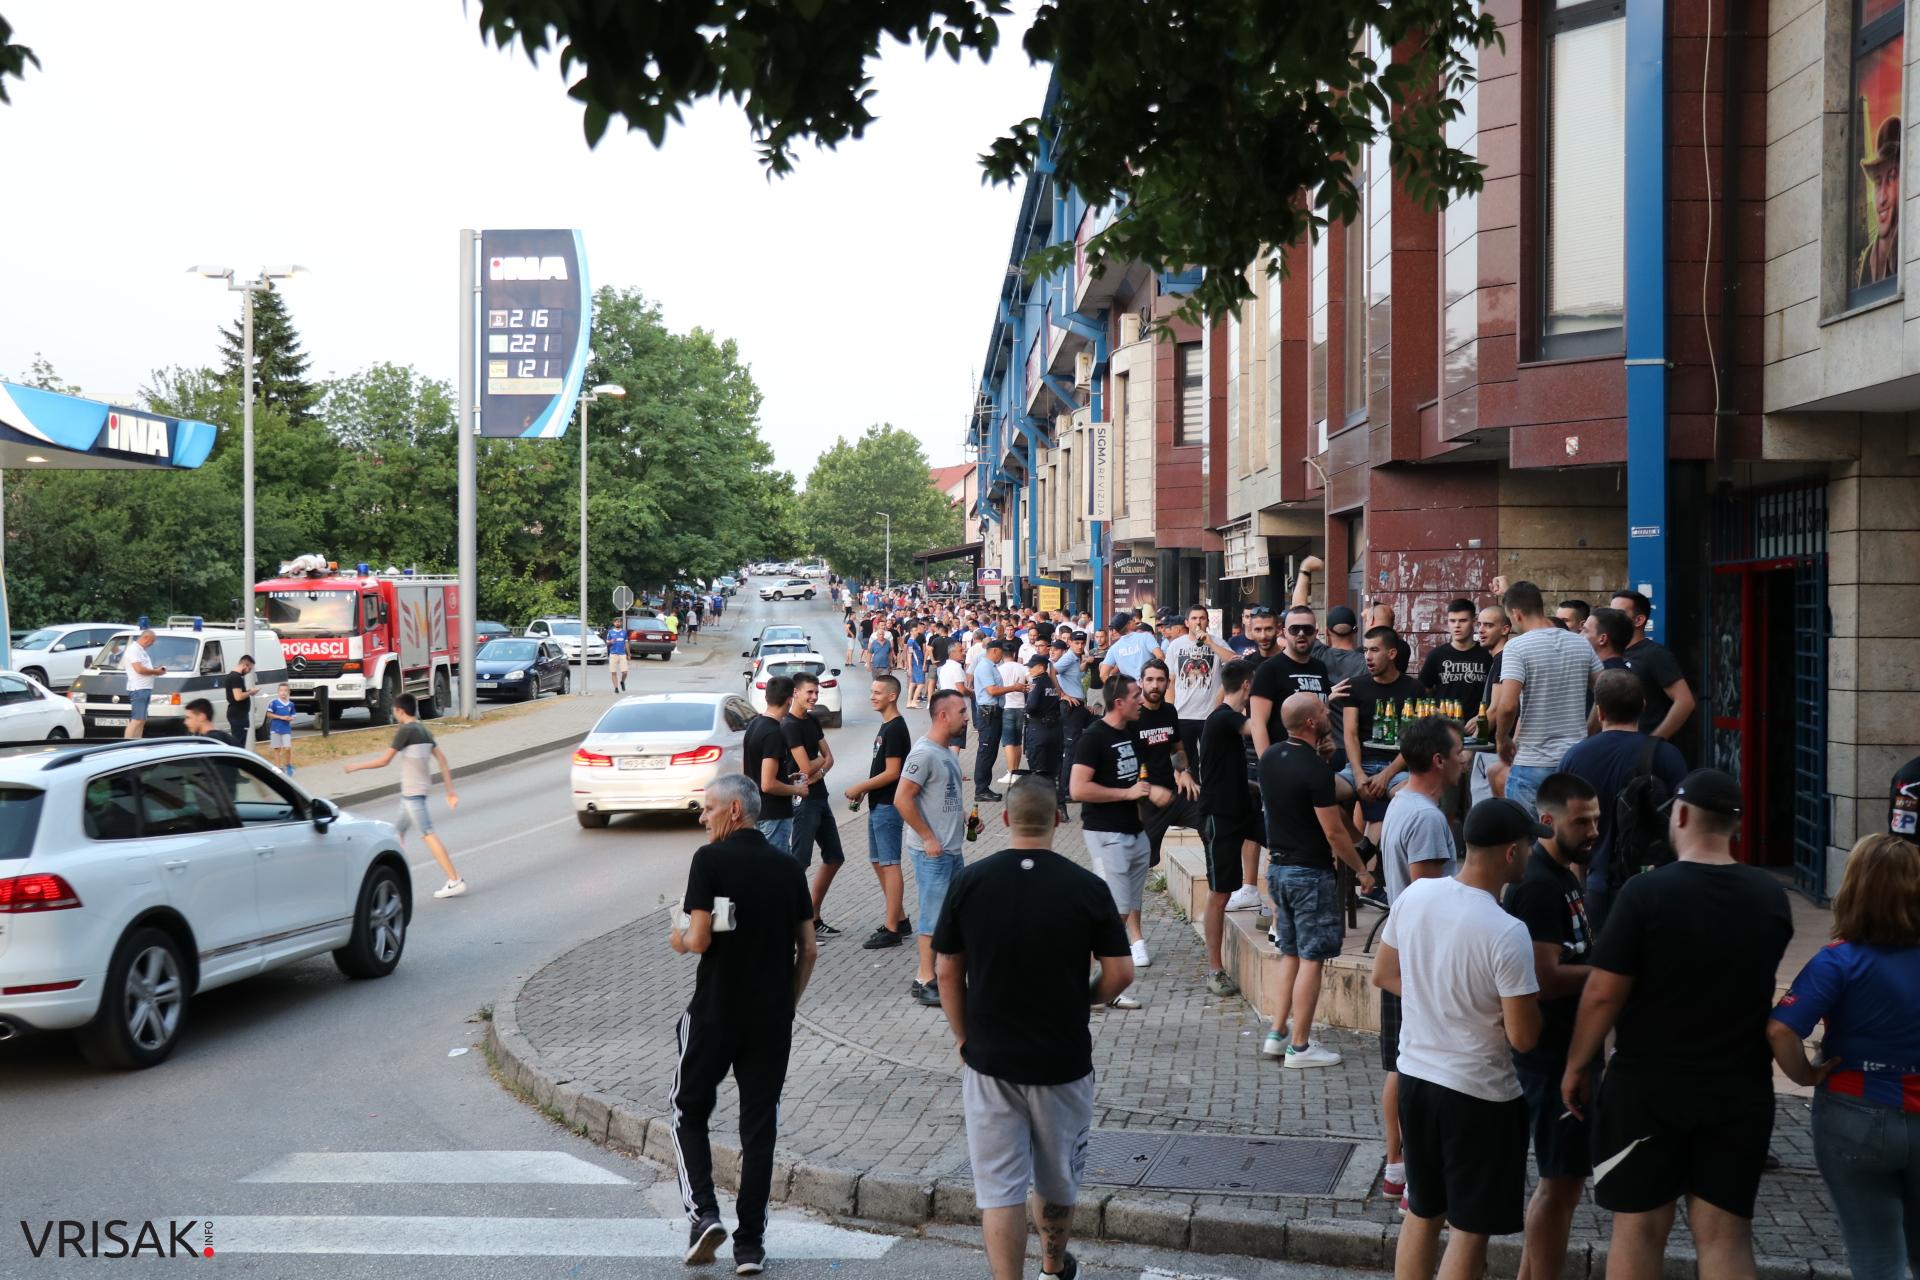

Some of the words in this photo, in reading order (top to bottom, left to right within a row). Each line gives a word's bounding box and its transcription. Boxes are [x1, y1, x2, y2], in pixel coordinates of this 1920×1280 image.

[108, 412, 169, 458] INA
[1097, 428, 1106, 466] SIGMA
[1097, 468, 1106, 515] REVIZIJA
[281, 642, 344, 655] ROGASCI
[1442, 660, 1485, 673] PITBULL
[1140, 726, 1174, 739] EVERYTHING
[906, 761, 919, 774] 19
